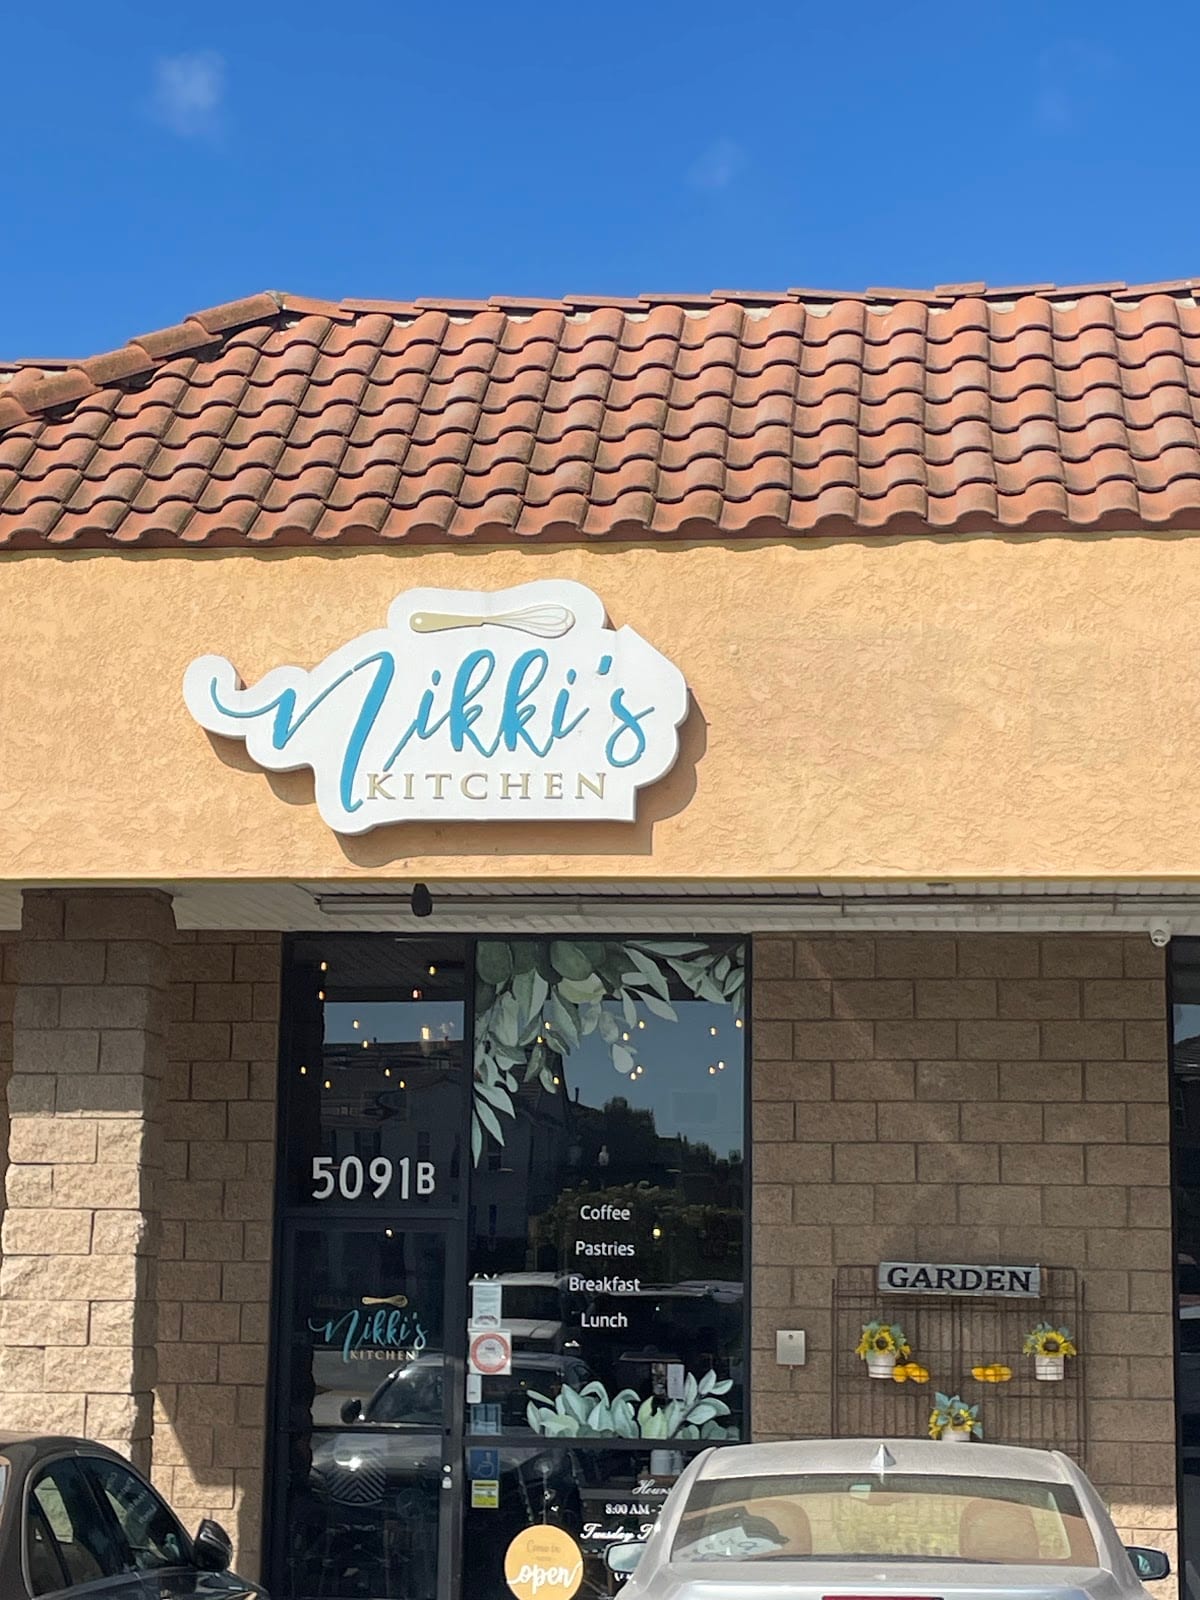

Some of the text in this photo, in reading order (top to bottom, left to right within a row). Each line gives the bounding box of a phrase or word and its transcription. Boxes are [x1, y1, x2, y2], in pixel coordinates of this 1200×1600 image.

[211, 649, 655, 812] Nikki's
[366, 771, 607, 800] KITCHEN
[580, 1204, 631, 1220] Coffee
[575, 1240, 635, 1256] Pastries
[569, 1276, 640, 1292] Breakfast
[887, 1266, 1032, 1292] GARDEN
[581, 1312, 628, 1327] Lunch
[308, 1309, 428, 1363] Nikki's
[350, 1349, 419, 1360] KITCHEN
[605, 1503, 628, 1515] 8:00
[629, 1503, 650, 1515] AM
[580, 1523, 635, 1542] Tuesday
[507, 1560, 583, 1595] open
